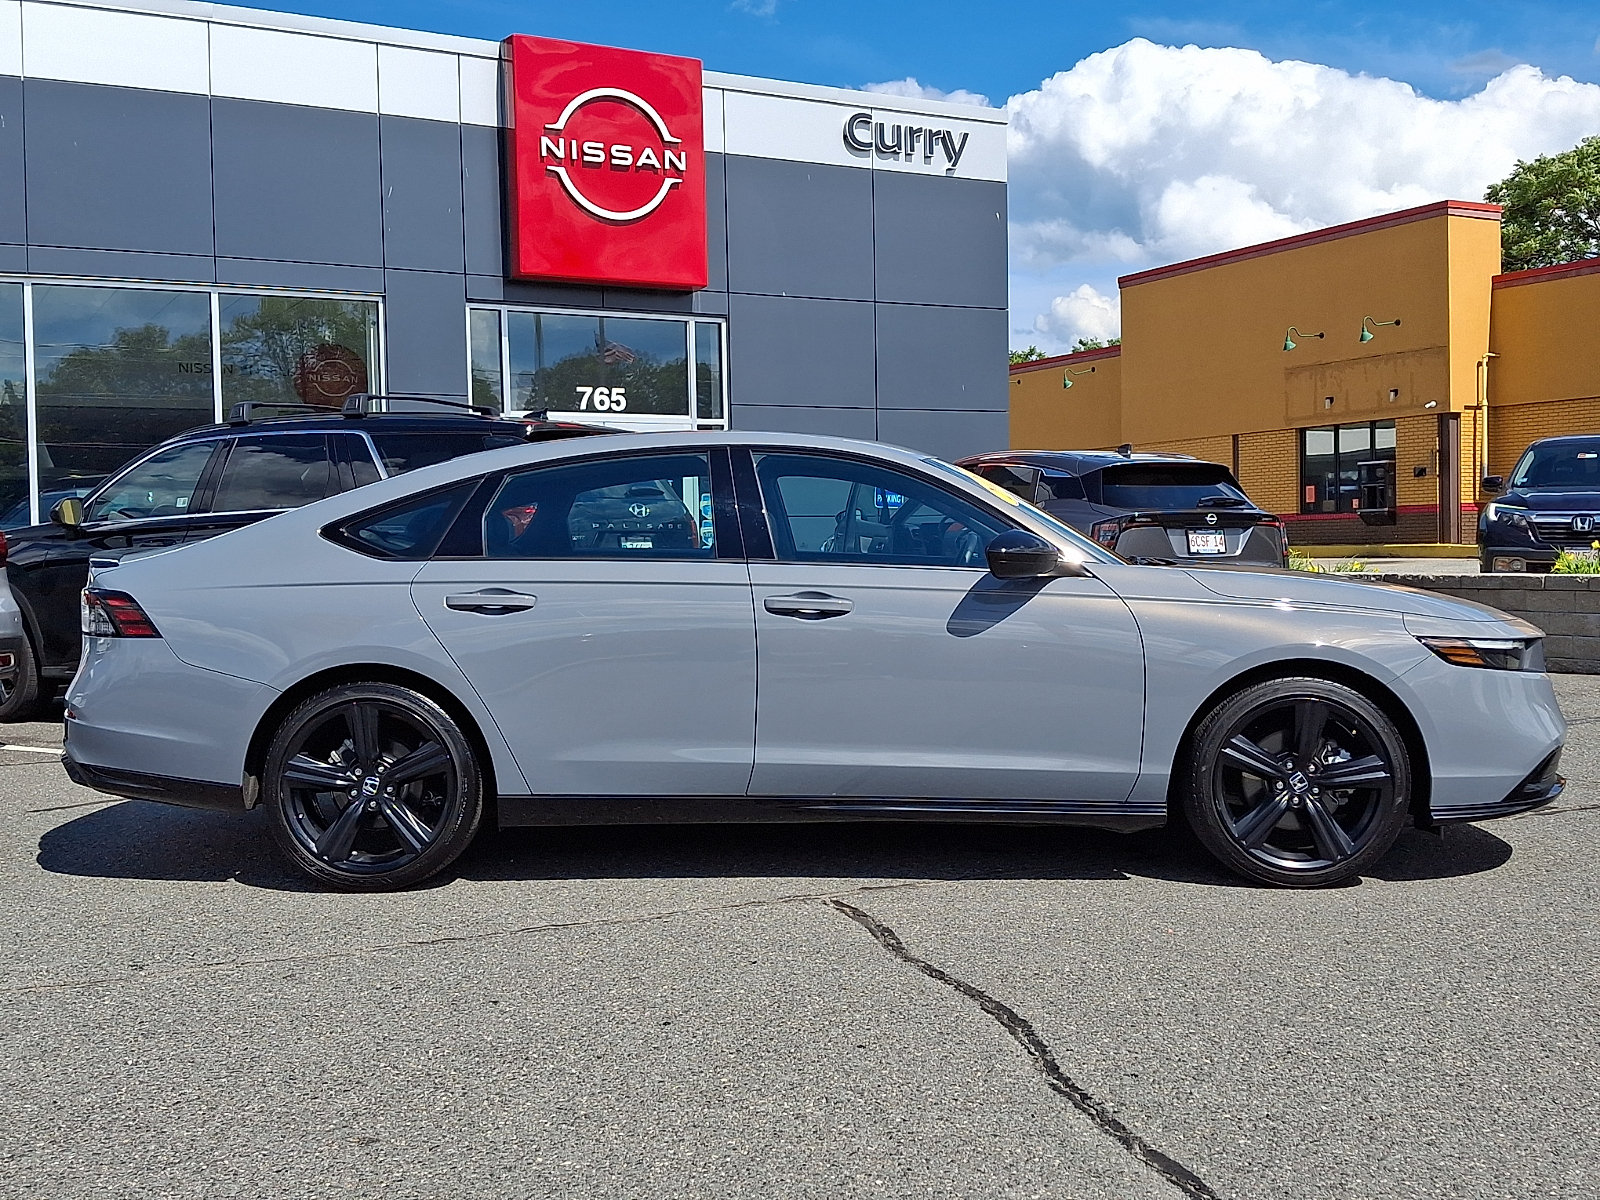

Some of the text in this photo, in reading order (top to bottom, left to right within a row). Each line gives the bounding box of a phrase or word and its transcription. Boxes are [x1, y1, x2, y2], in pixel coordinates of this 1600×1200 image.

[844, 112, 969, 168] Curry
[540, 134, 686, 171] NISSAN
[178, 362, 233, 374] NISSN
[309, 372, 358, 384] NISSAN
[575, 386, 627, 412] 765
[592, 522, 682, 530] PALISADE
[1190, 535, 1224, 547] 6CSF 14
